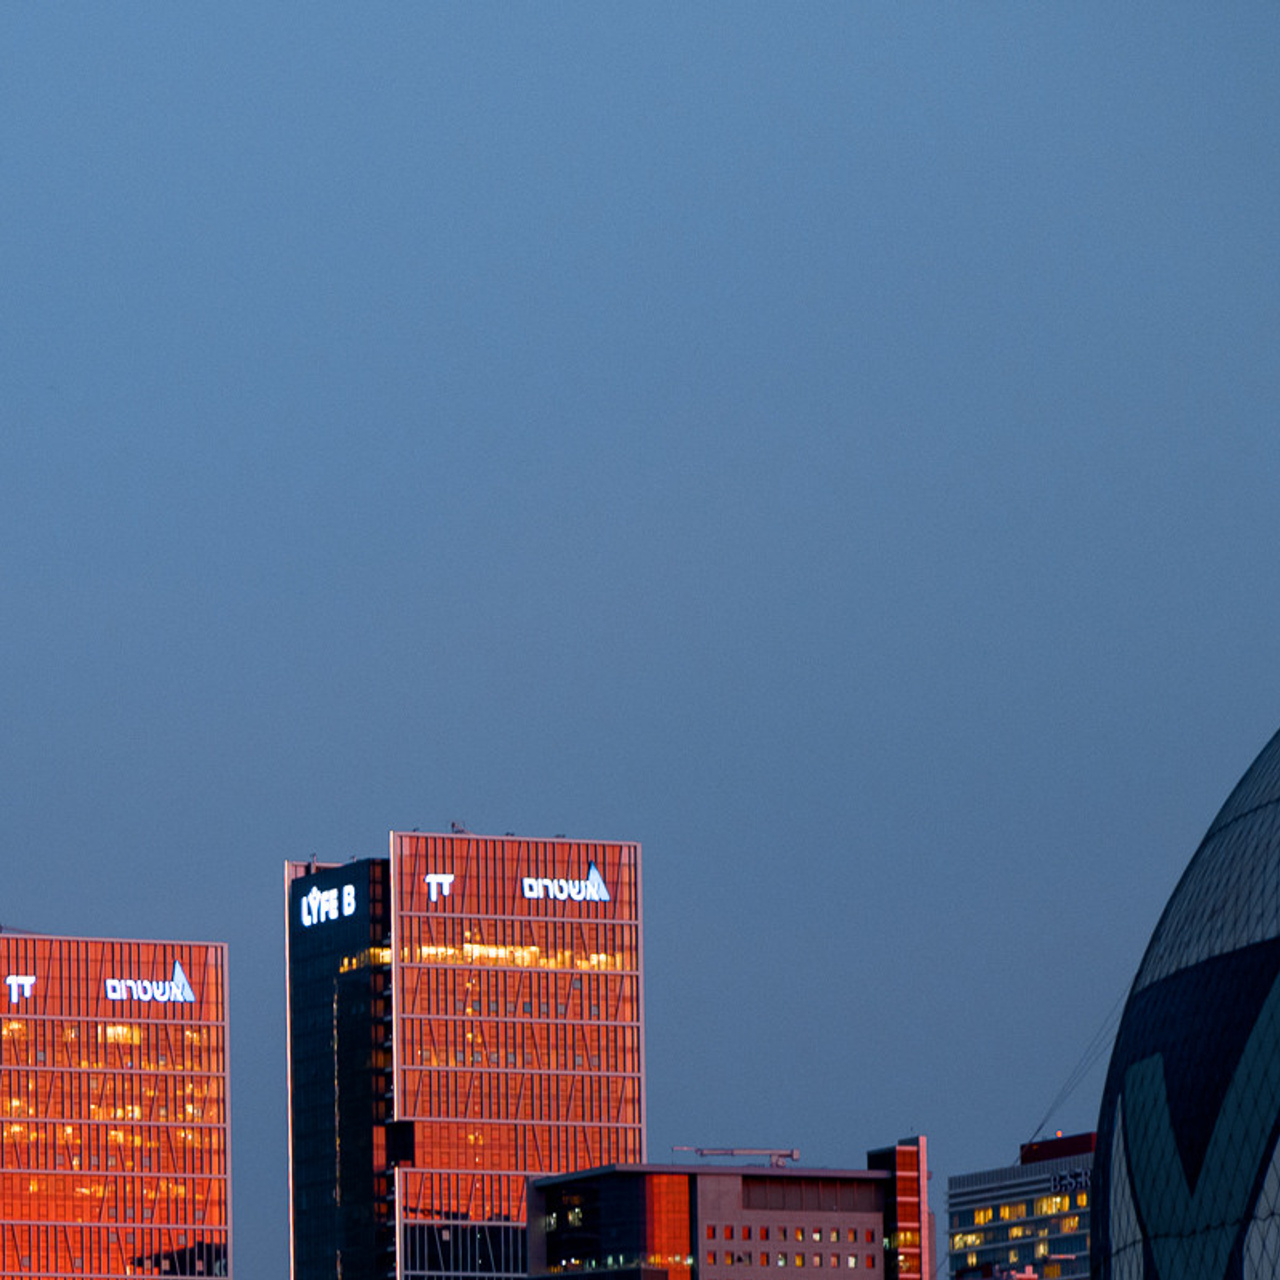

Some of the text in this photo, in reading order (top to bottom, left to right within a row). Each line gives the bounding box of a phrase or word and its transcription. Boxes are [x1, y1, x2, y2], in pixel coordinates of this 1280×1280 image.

[342, 884, 356, 917] B
[521, 874, 604, 902] אשטרום
[104, 976, 190, 1002] אשטרום
